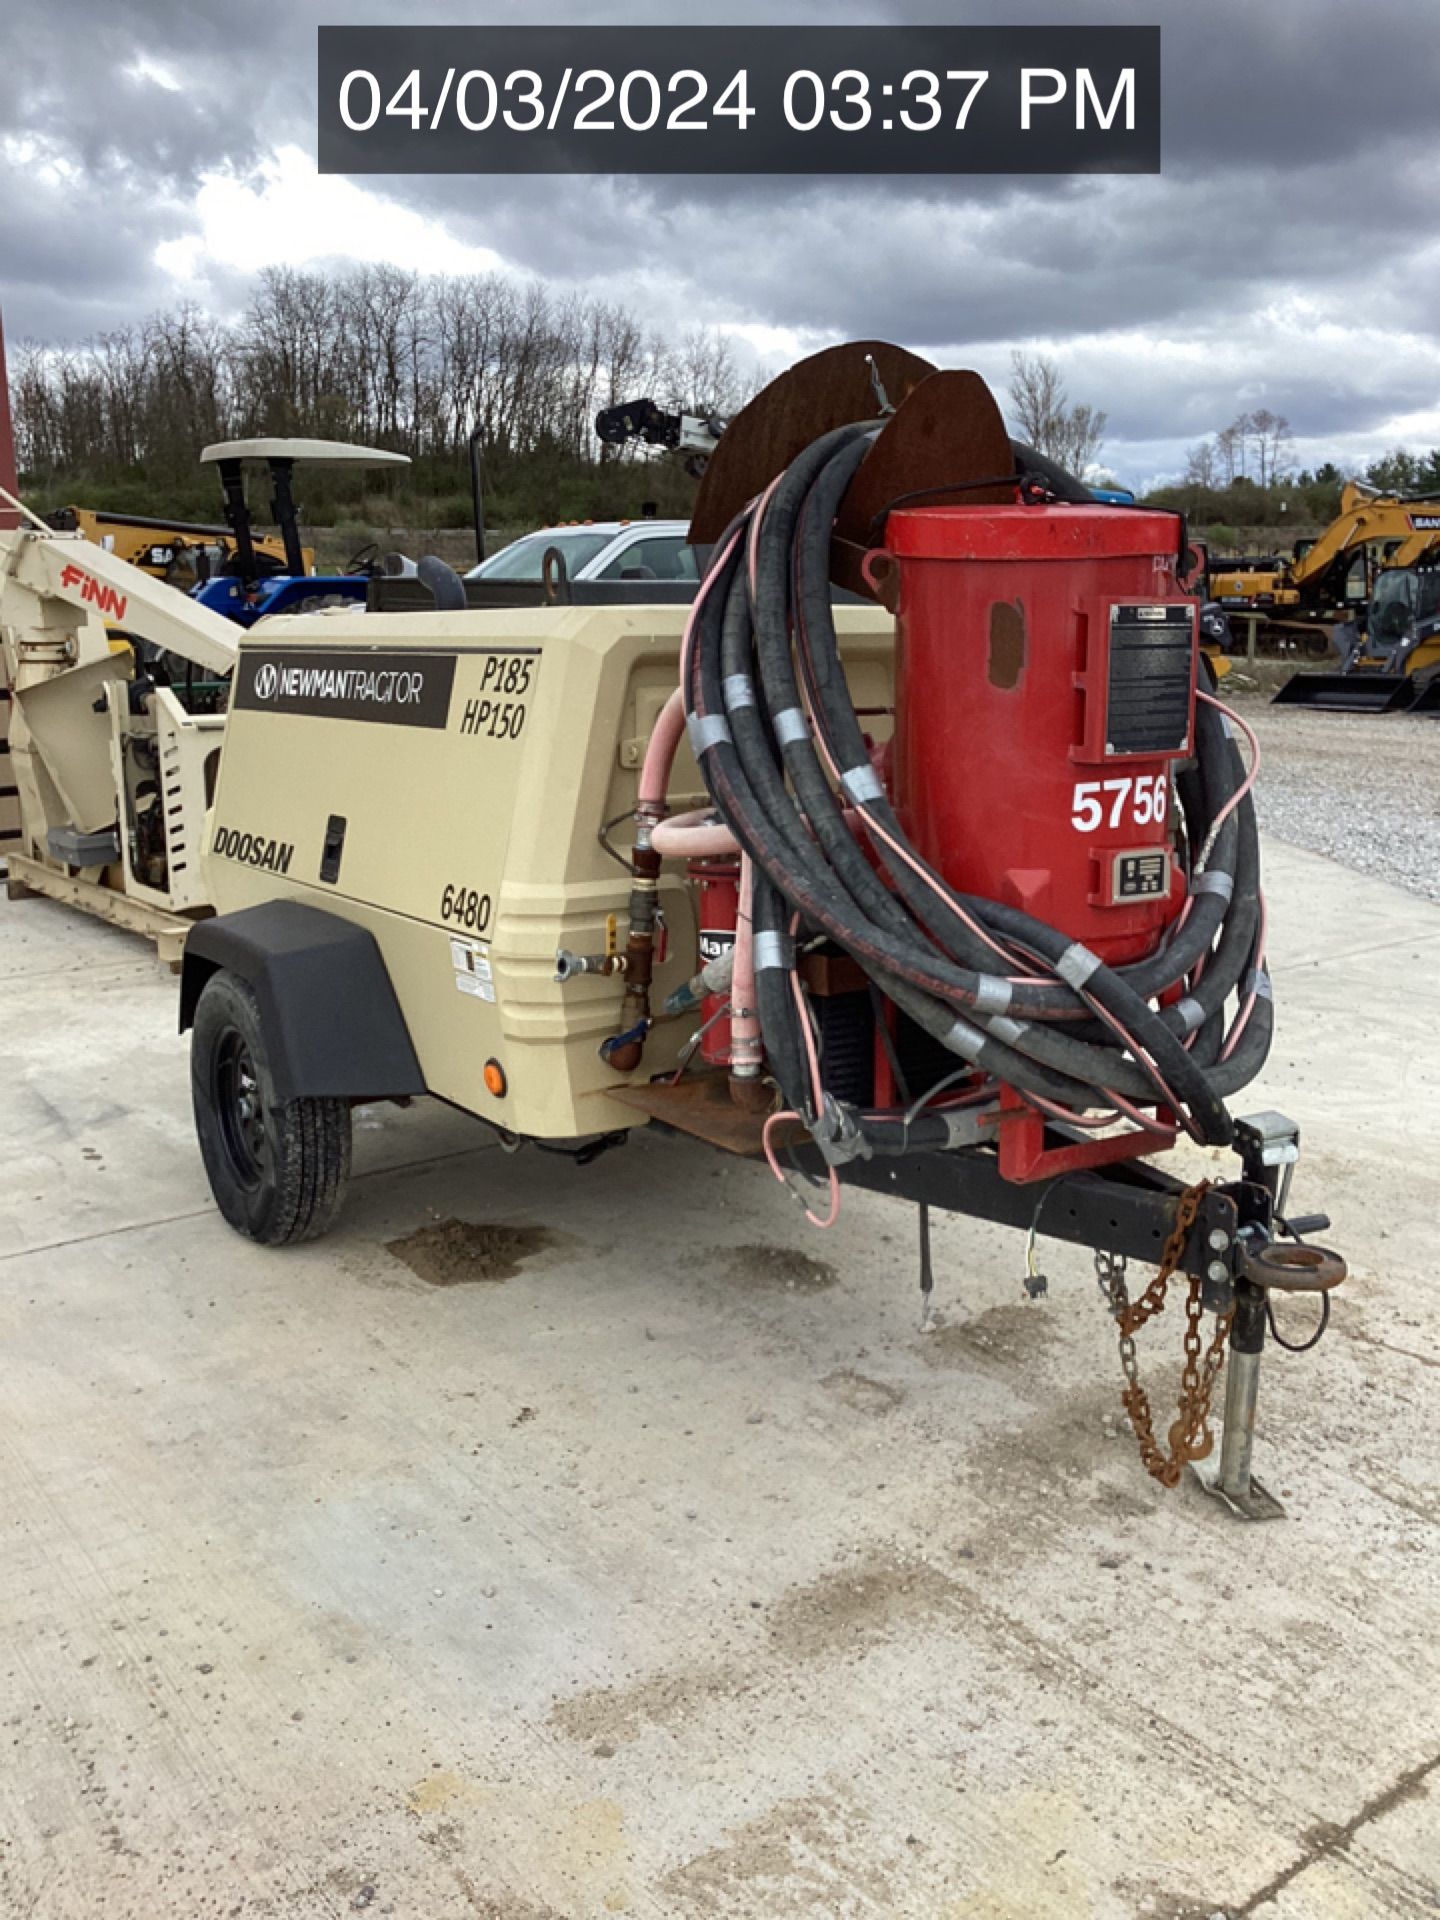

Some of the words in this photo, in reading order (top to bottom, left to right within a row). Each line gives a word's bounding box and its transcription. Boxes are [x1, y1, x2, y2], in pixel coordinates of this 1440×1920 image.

[480, 656, 534, 694] P185
[460, 699, 526, 739] HP150
[1071, 775, 1167, 832] 5756
[213, 826, 295, 874] DOOSAN
[441, 884, 491, 932] 6480
